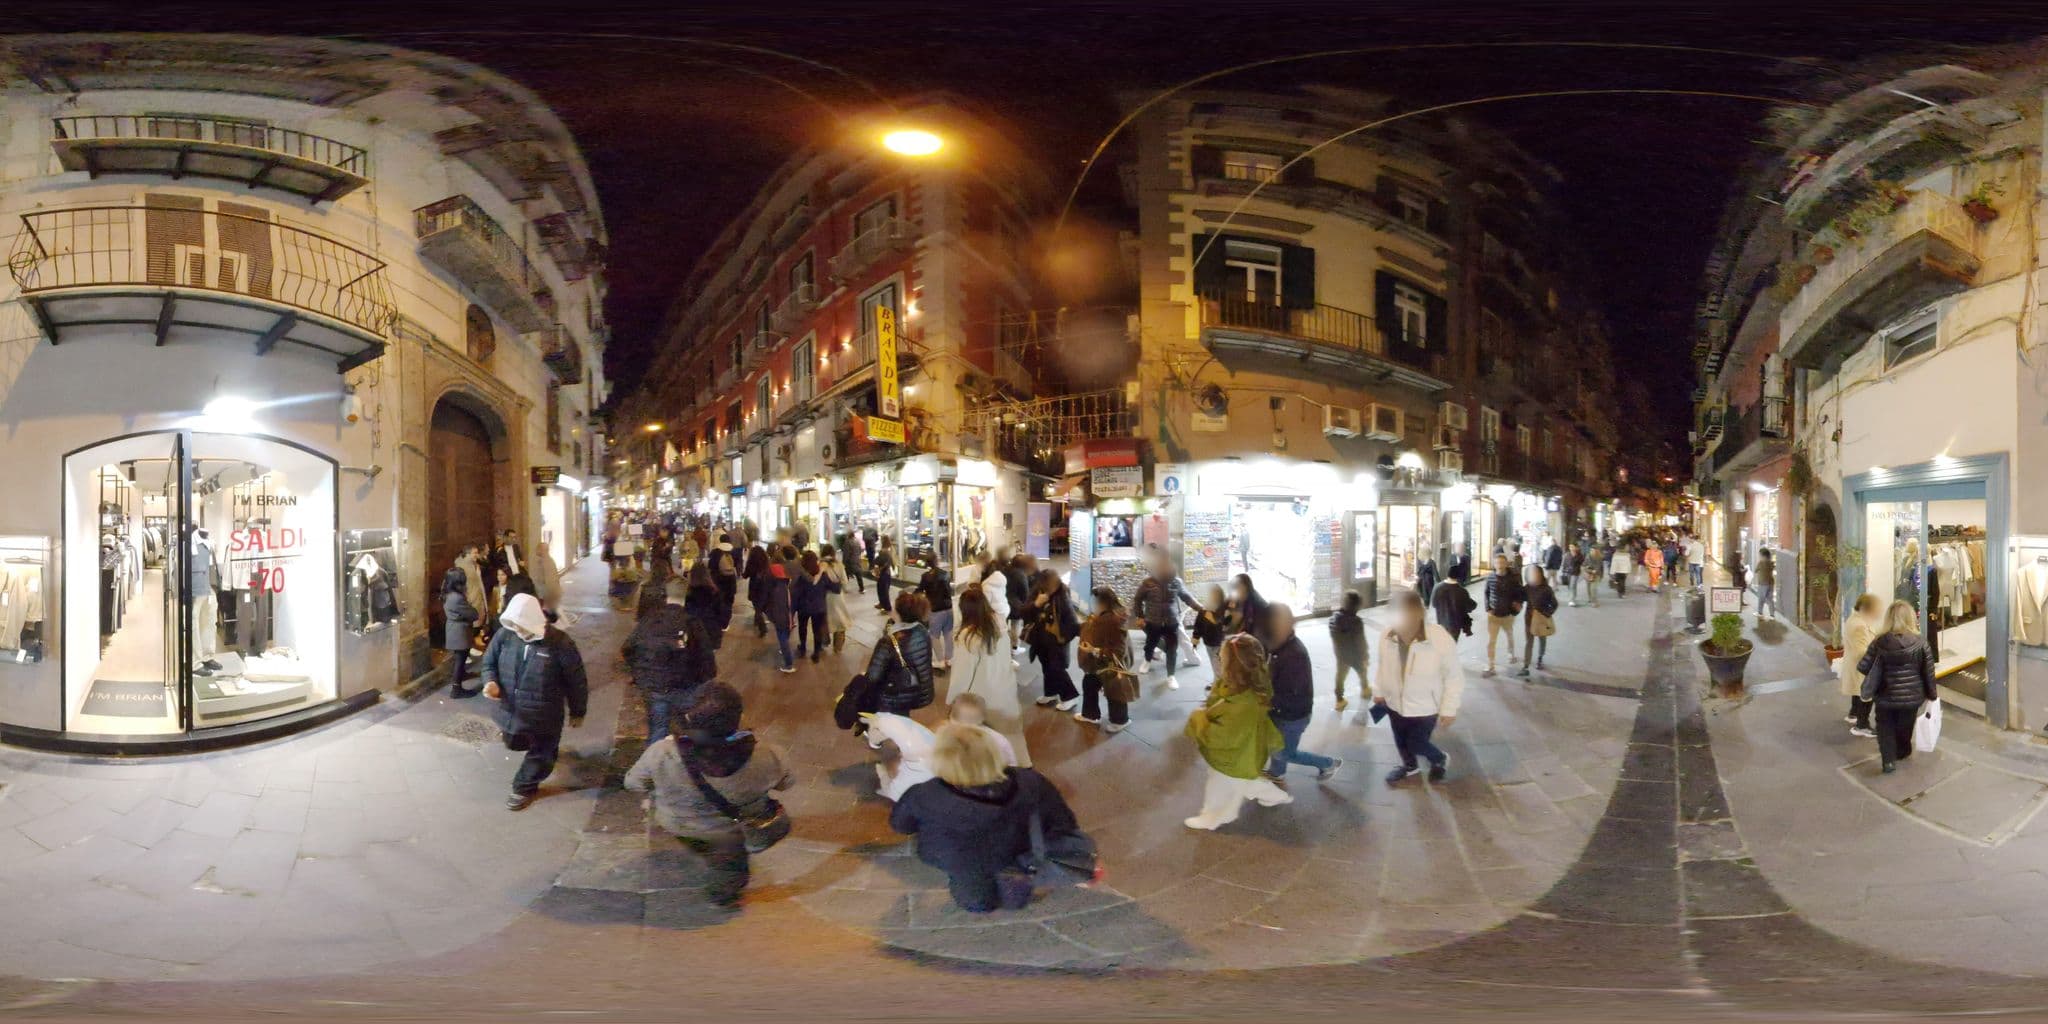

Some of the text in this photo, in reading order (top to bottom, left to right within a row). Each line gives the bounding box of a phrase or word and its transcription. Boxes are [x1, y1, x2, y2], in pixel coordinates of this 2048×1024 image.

[881, 308, 895, 396] BRANDI
[233, 494, 297, 506] I'M BRIAN
[230, 528, 303, 552] SALDI
[248, 567, 285, 595] -70
[115, 693, 164, 702] BRIAN
